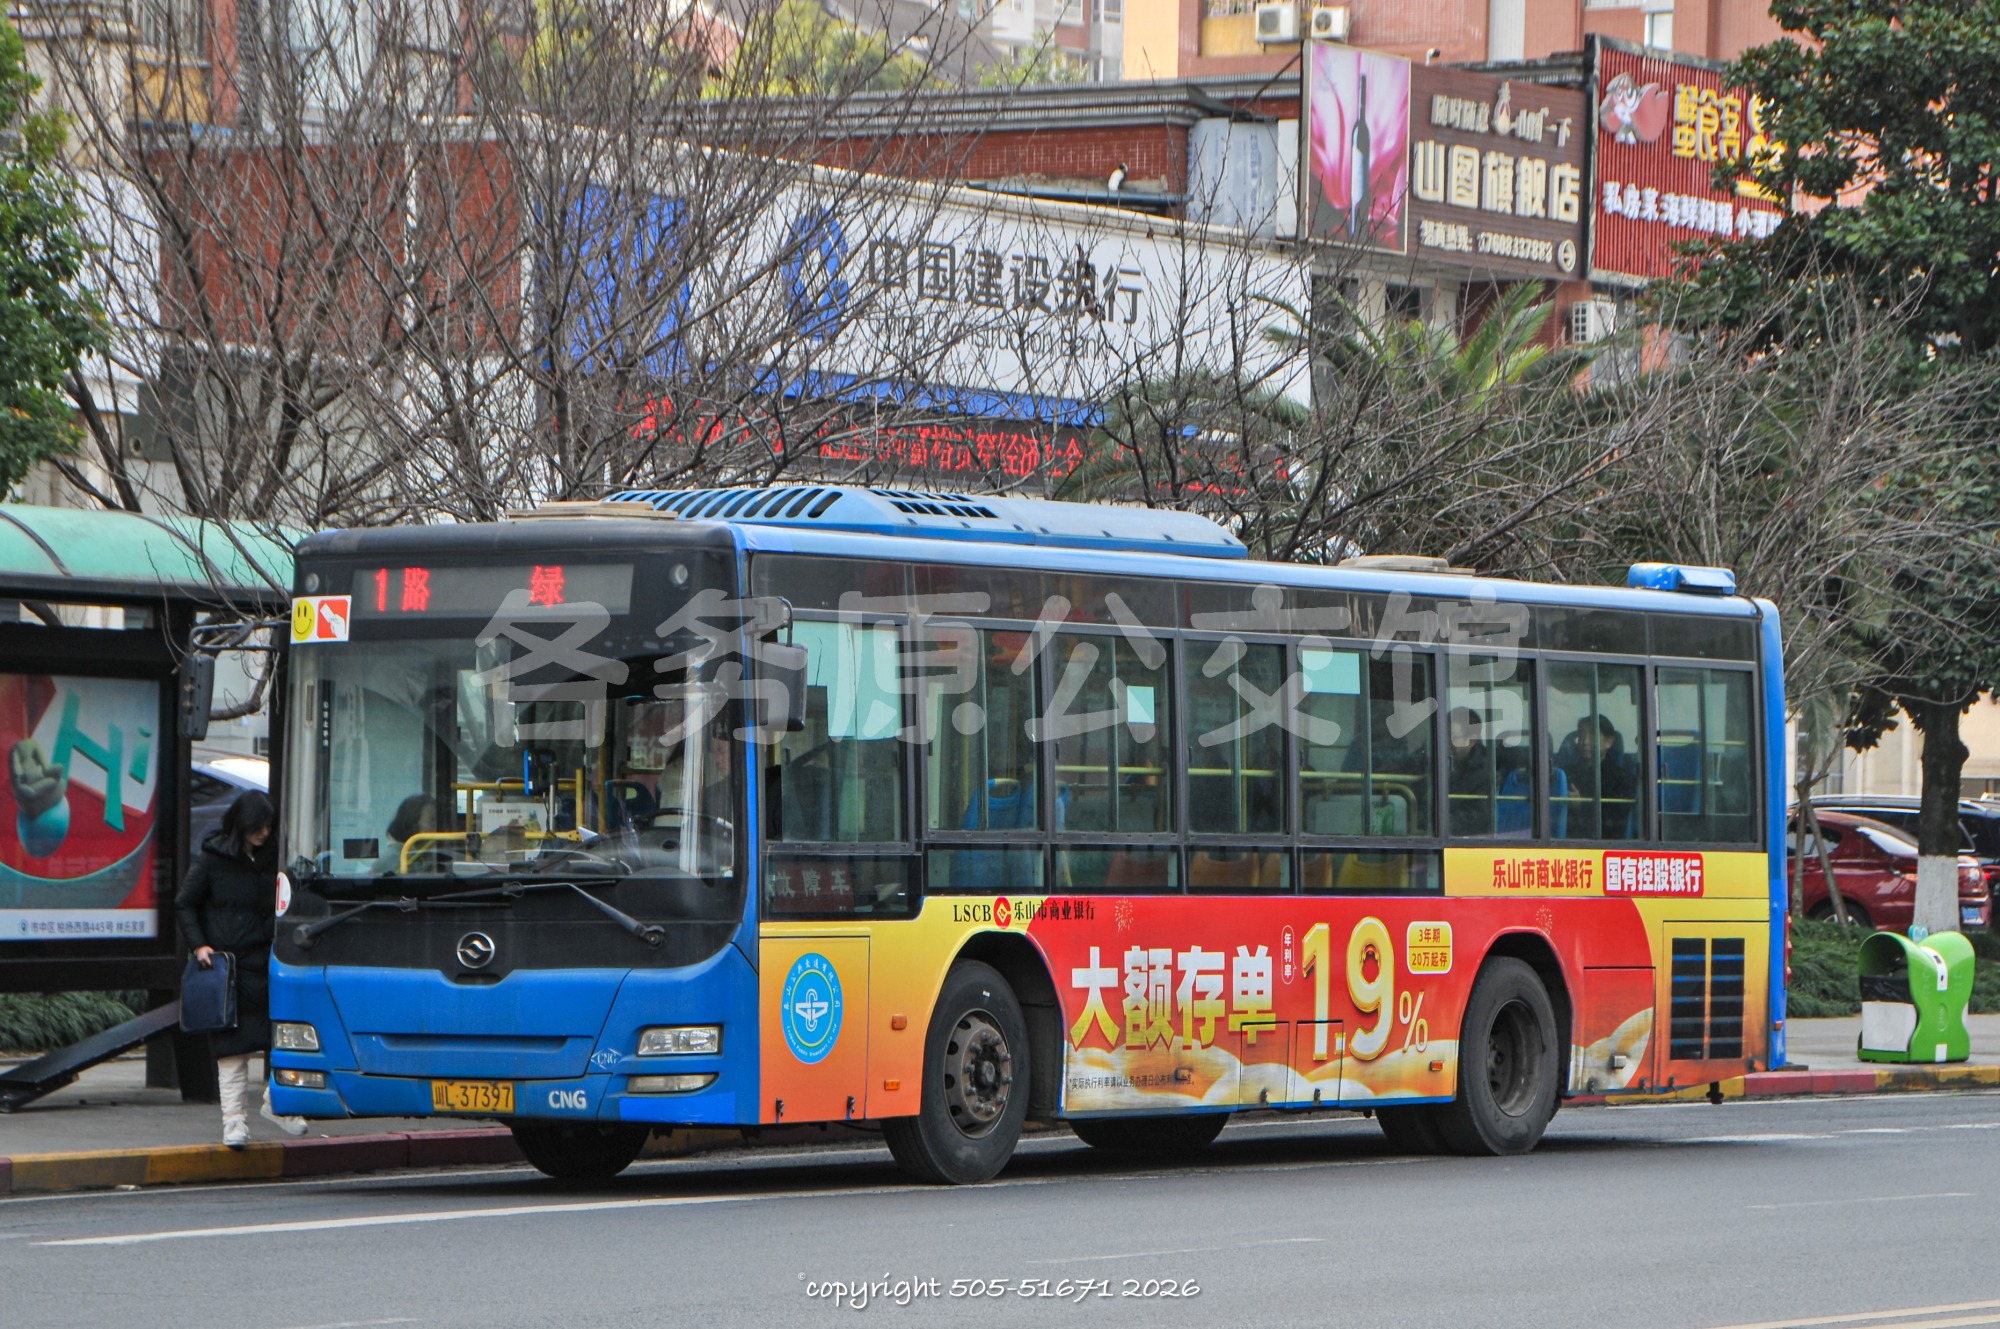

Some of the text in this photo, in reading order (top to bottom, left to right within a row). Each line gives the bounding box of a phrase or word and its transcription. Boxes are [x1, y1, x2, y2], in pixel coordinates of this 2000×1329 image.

[1413, 139, 1581, 223] 山图旗舰店
[867, 238, 1143, 324] 中国建设银行
[375, 565, 564, 612] 1路 绿
[1493, 856, 1701, 893] 乐山市商业银行 国有控股银行
[953, 900, 1096, 923] LSCB 乐山市商业银行
[1283, 930, 1294, 977] 年利率
[1418, 928, 1441, 943] 3年期
[1411, 951, 1448, 968] 20万起存
[1071, 943, 1275, 1052] 大额存单
[549, 1090, 587, 1110] CNG
